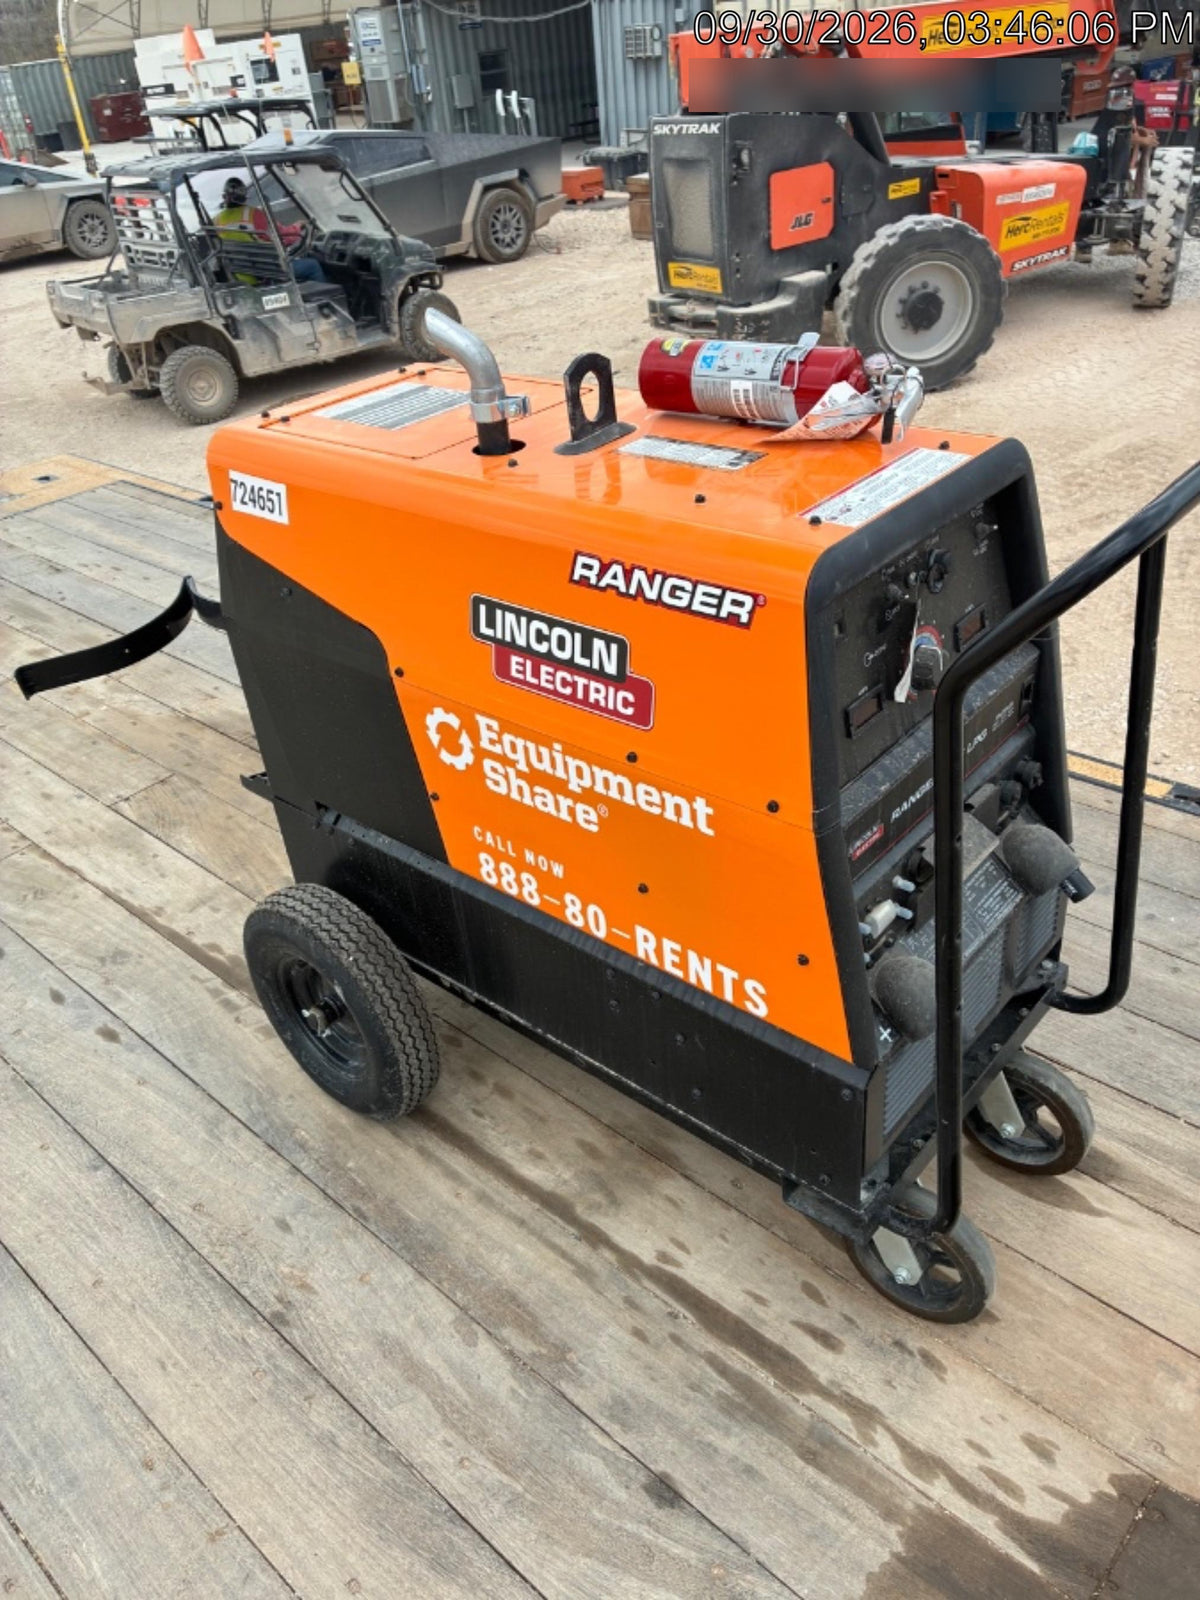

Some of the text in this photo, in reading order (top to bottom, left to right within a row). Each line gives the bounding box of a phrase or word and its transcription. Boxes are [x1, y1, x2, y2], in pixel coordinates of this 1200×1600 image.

[653, 122, 721, 135] SKYTRAK
[790, 212, 814, 231] JLG
[1012, 247, 1067, 271] SKYTRAK
[230, 478, 282, 516] 724651
[479, 604, 618, 676] LINCOLN
[510, 655, 635, 716] ELECTRIC
[474, 714, 715, 837] Equipment
[473, 825, 564, 879] CALL NOW
[478, 852, 768, 1018] 888-80-RENTS
